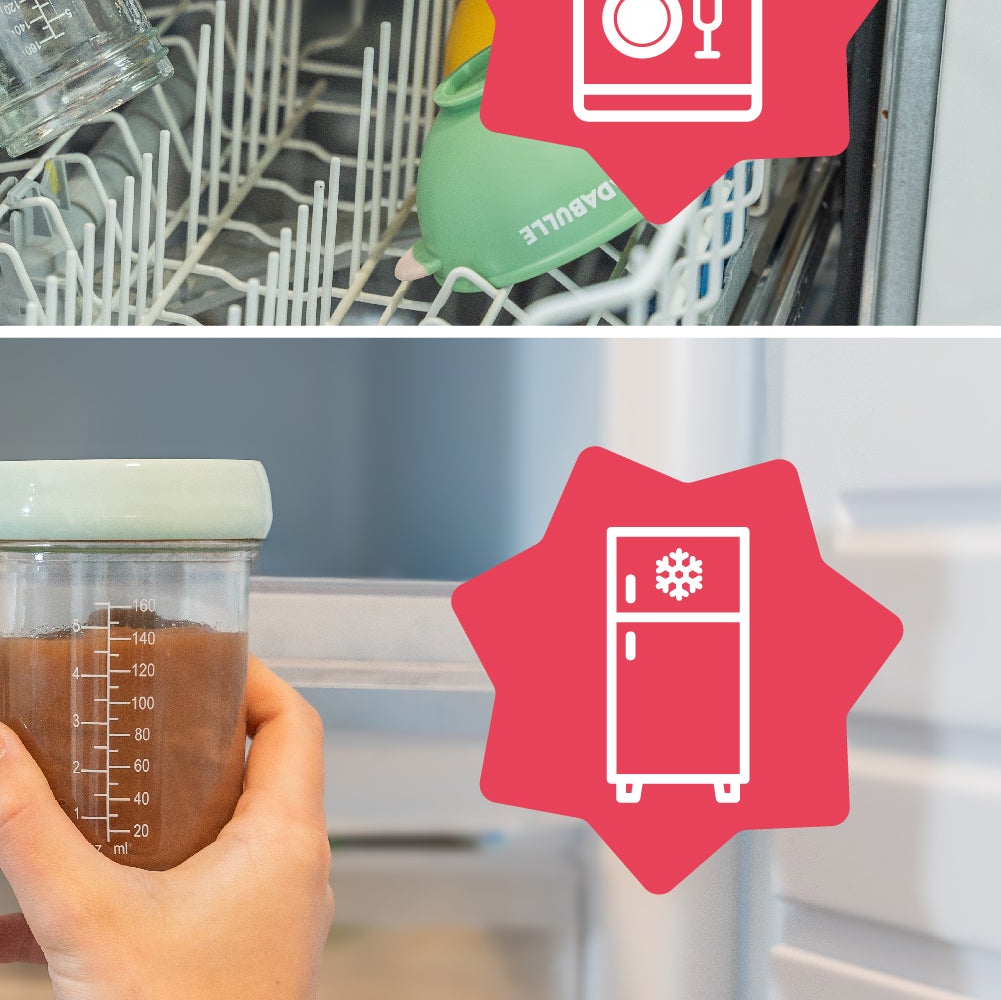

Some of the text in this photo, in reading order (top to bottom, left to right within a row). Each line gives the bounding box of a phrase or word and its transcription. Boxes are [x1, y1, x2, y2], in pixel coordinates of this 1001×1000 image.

[4, 0, 21, 15] 120
[65, 8, 73, 18] 5
[14, 20, 31, 35] 140
[25, 41, 42, 56] 160
[519, 179, 617, 246] DABULLE
[132, 599, 156, 612] 160
[72, 619, 80, 632] 5
[132, 632, 156, 645] 140
[72, 668, 80, 679] 4
[132, 664, 155, 677] 120
[131, 697, 155, 710] 100
[72, 714, 80, 728] 3
[134, 728, 150, 741] 80
[72, 761, 80, 773] 2
[133, 759, 150, 772] 60
[133, 792, 150, 805] 40
[74, 807, 79, 819] 1
[133, 823, 149, 837] 20
[113, 842, 128, 854] ml
